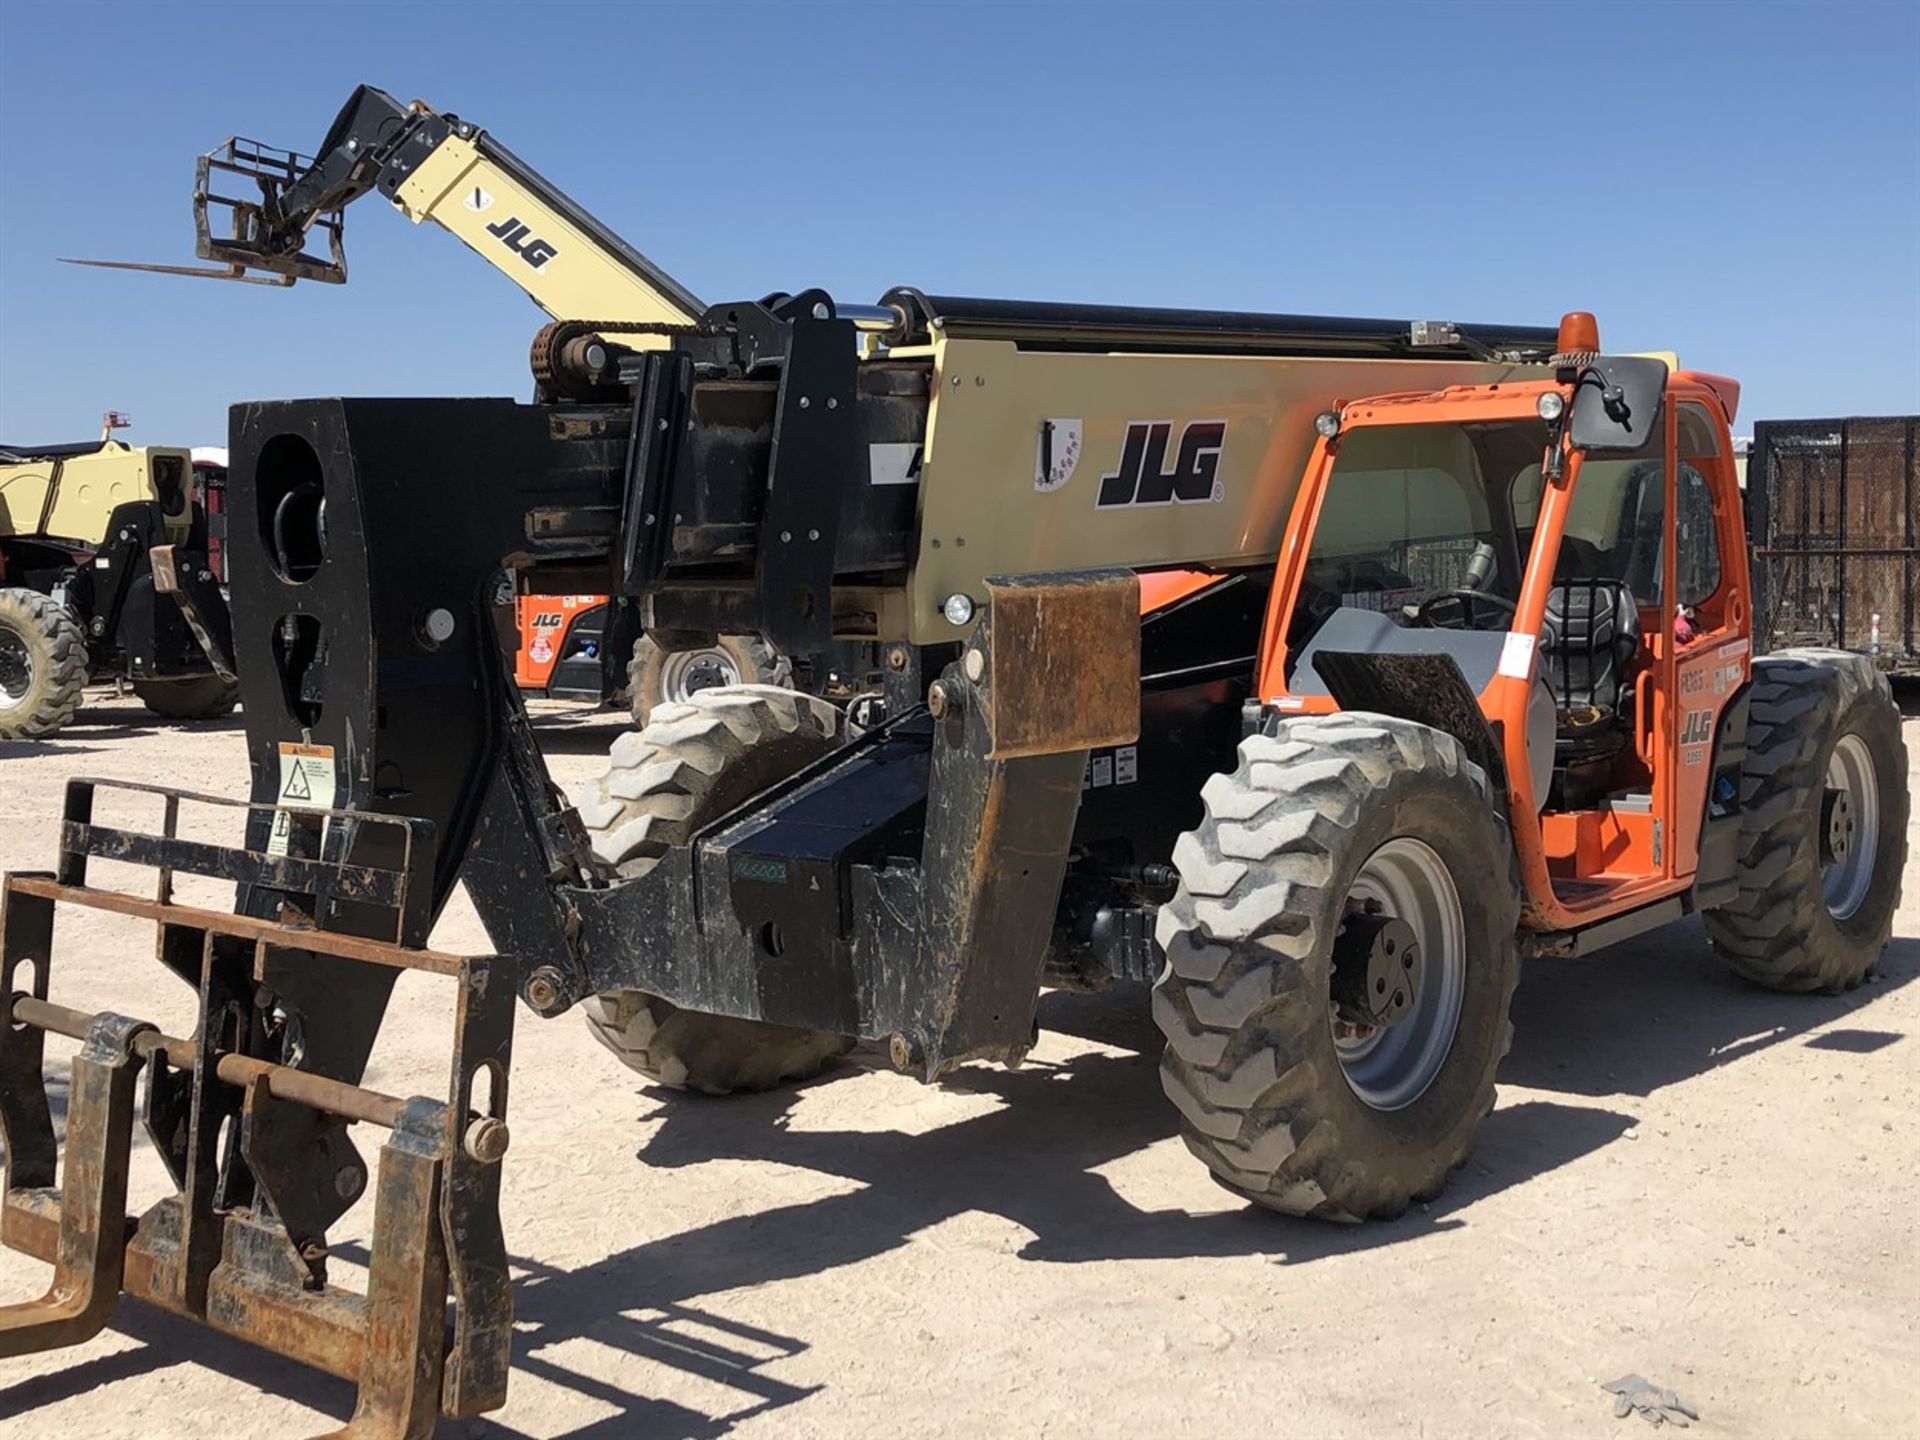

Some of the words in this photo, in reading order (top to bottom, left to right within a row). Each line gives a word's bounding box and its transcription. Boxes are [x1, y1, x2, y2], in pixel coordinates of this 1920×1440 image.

[485, 217, 559, 269] JLG
[1097, 422, 1226, 506] JLG
[531, 614, 561, 627] JLG
[1680, 710, 1713, 745] JLG
